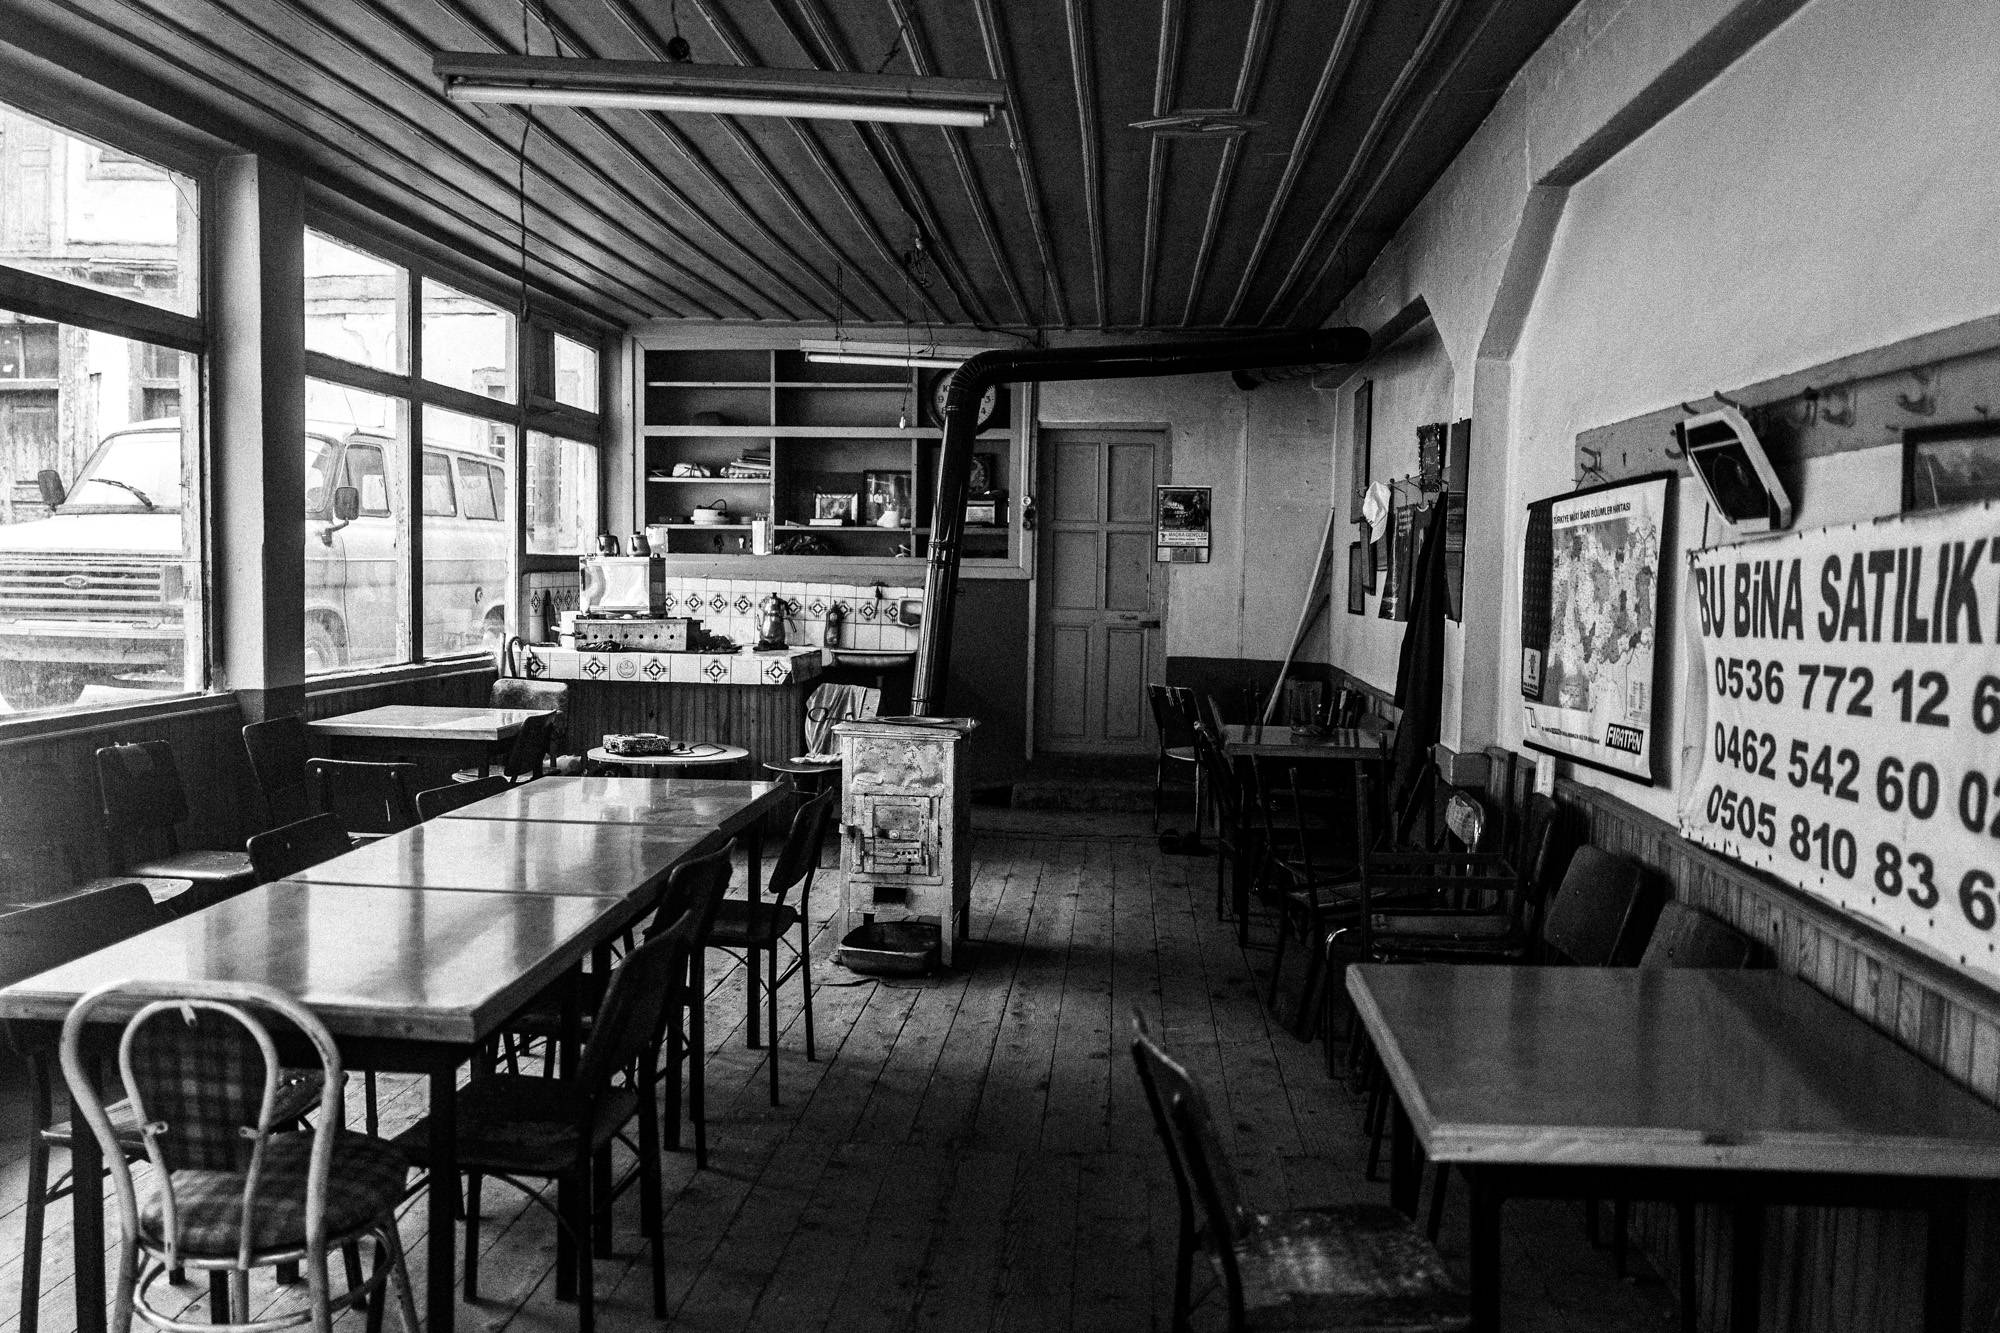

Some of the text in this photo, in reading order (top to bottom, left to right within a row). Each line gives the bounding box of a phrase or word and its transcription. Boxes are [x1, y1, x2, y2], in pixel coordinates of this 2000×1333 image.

[1696, 564, 1726, 639] BU
[1715, 656, 1784, 705] 0536
[1798, 663, 1875, 718] 772
[1891, 668, 1950, 728] 12
[1606, 726, 1642, 753] FIRATPEN
[1714, 721, 1777, 781] 0462
[1787, 738, 1860, 803] 542
[1876, 756, 1939, 820] 60
[1706, 784, 1777, 848] 0505
[1789, 813, 1857, 879] 810
[1874, 841, 1940, 910] 83
